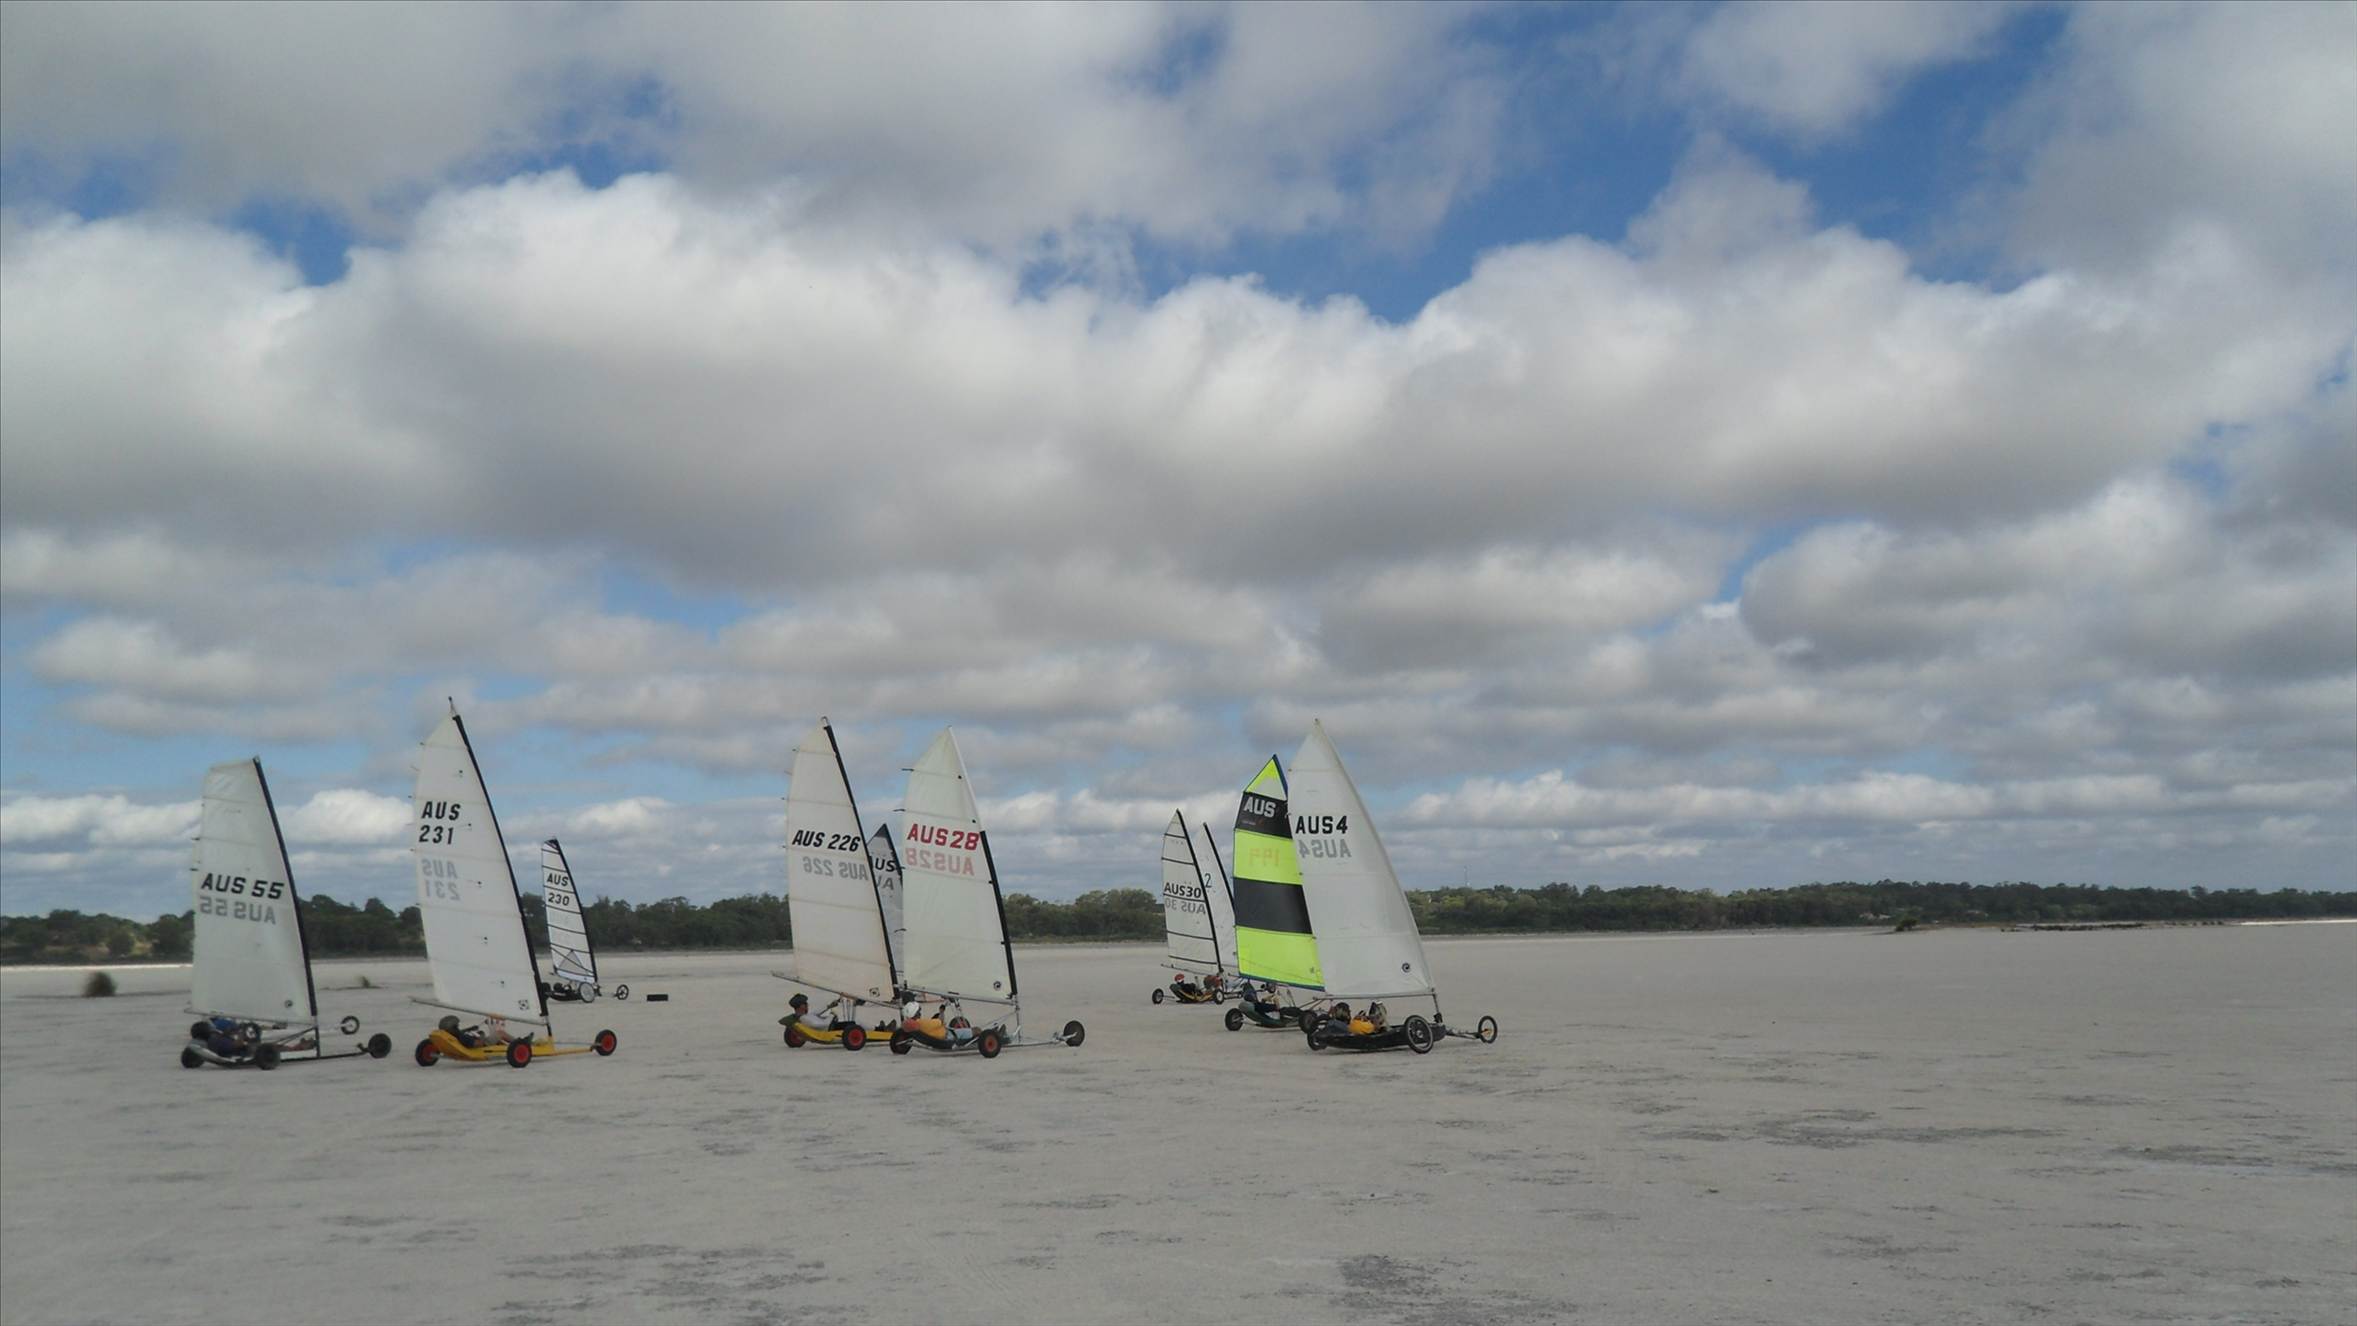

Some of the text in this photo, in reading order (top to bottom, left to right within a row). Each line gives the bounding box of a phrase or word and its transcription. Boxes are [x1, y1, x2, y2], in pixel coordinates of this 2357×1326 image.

[421, 801, 461, 821] AUS
[1243, 796, 1276, 818] AUS
[418, 825, 454, 845] 231
[792, 829, 861, 852] AUS 226
[201, 873, 284, 899] AUS 55
[547, 873, 569, 886] AUS
[548, 892, 570, 906] 230
